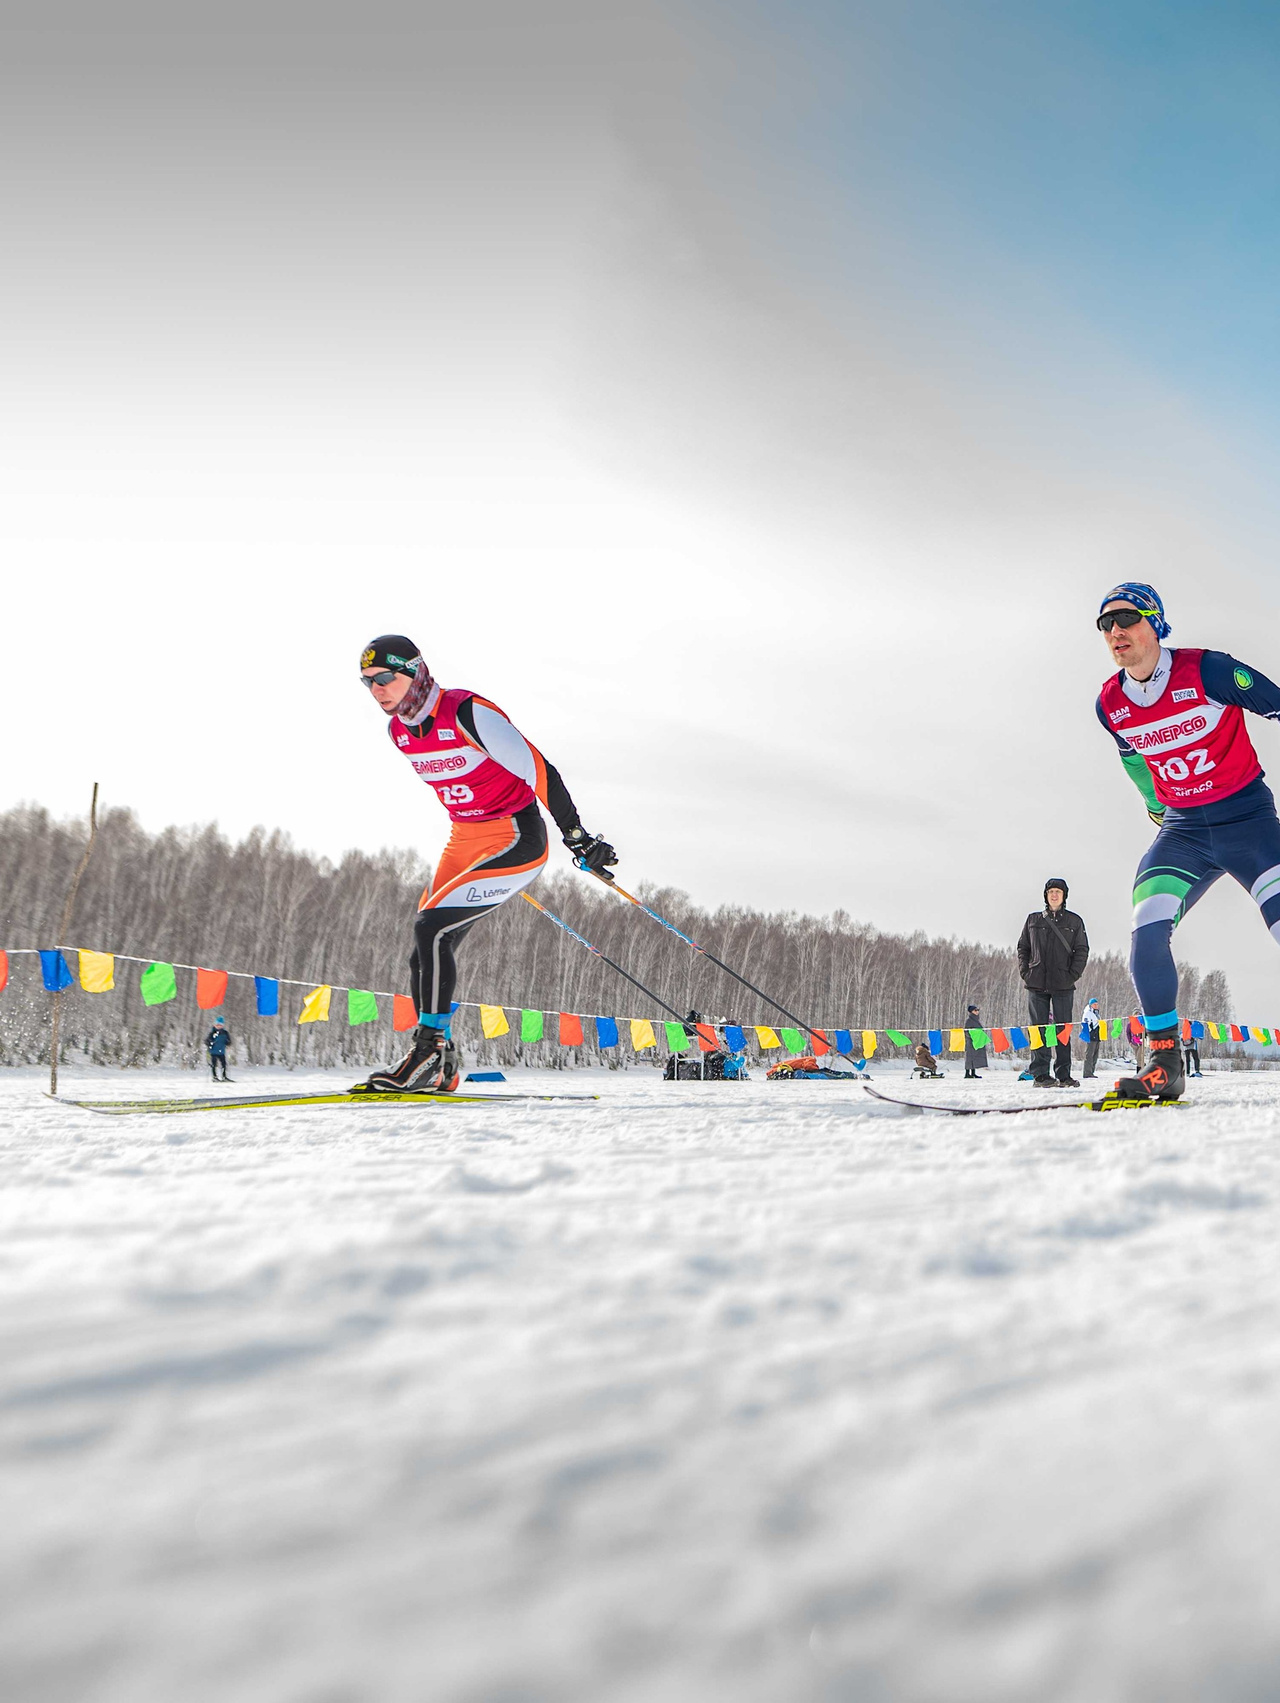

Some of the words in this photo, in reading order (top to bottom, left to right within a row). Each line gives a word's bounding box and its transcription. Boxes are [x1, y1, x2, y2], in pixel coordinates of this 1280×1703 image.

[1150, 748, 1216, 781] 102
[483, 887, 511, 898] Löffler
[350, 1094, 403, 1102] FISCHER
